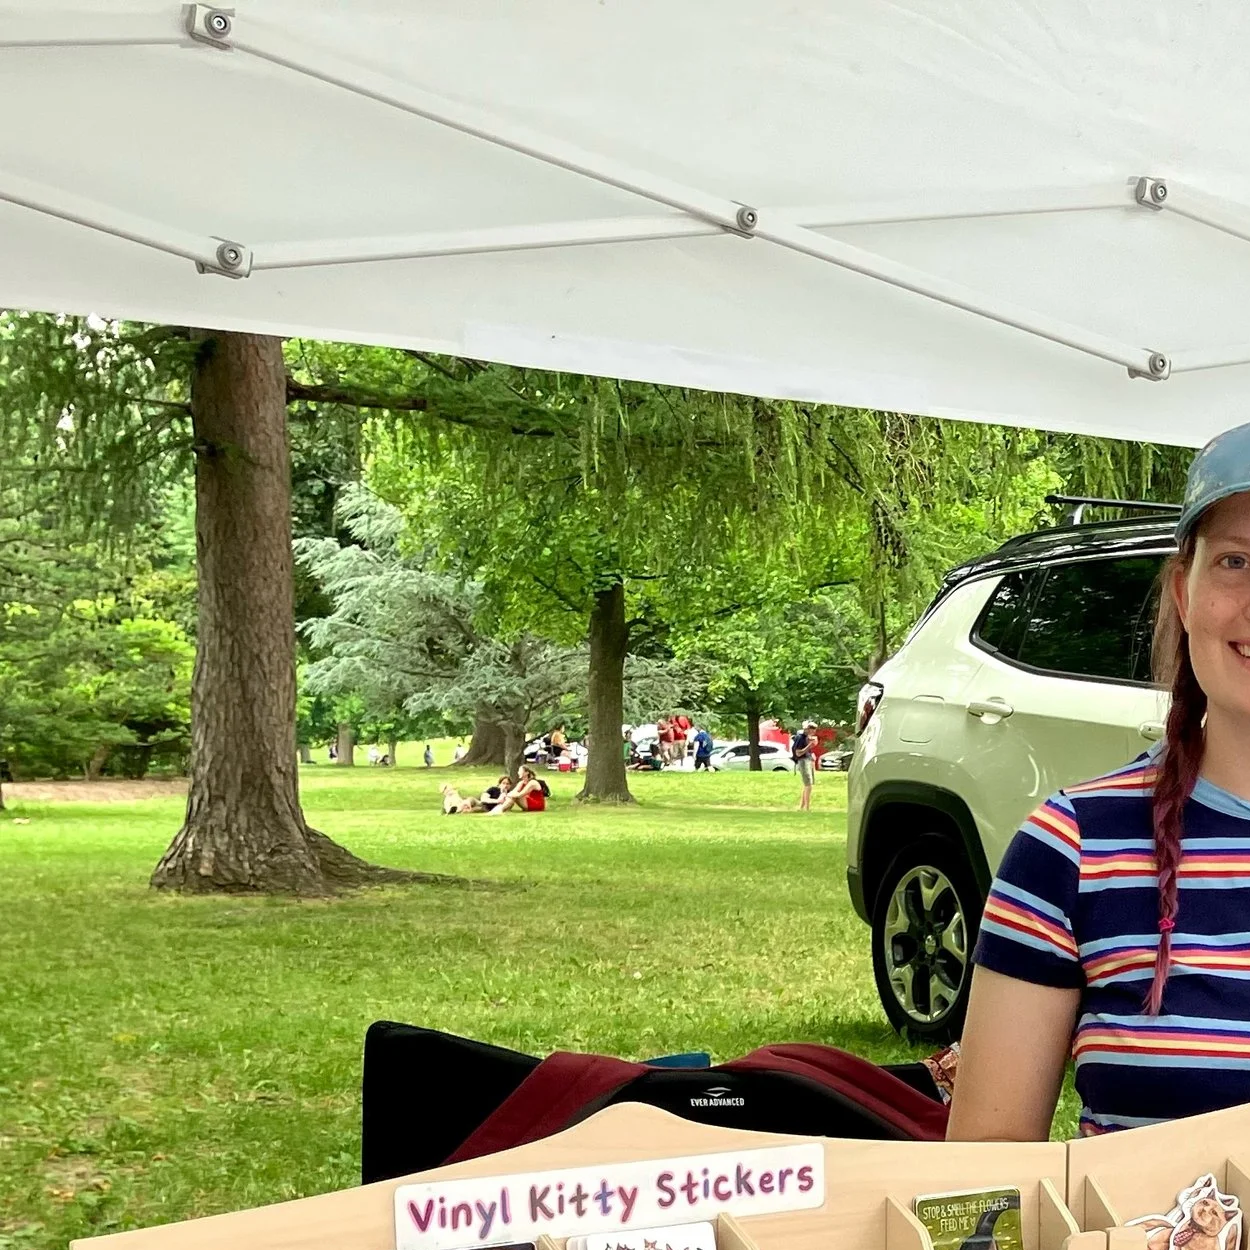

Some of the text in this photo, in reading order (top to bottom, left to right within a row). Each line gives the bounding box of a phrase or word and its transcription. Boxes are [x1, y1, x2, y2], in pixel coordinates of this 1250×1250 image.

[690, 1098, 745, 1106] EVER ADVANCED
[409, 1163, 814, 1239] Vinyl Kitty Stickers
[923, 1205, 940, 1220] STOP
[965, 1201, 978, 1214] THE
[940, 1216, 970, 1232] FEED ME
